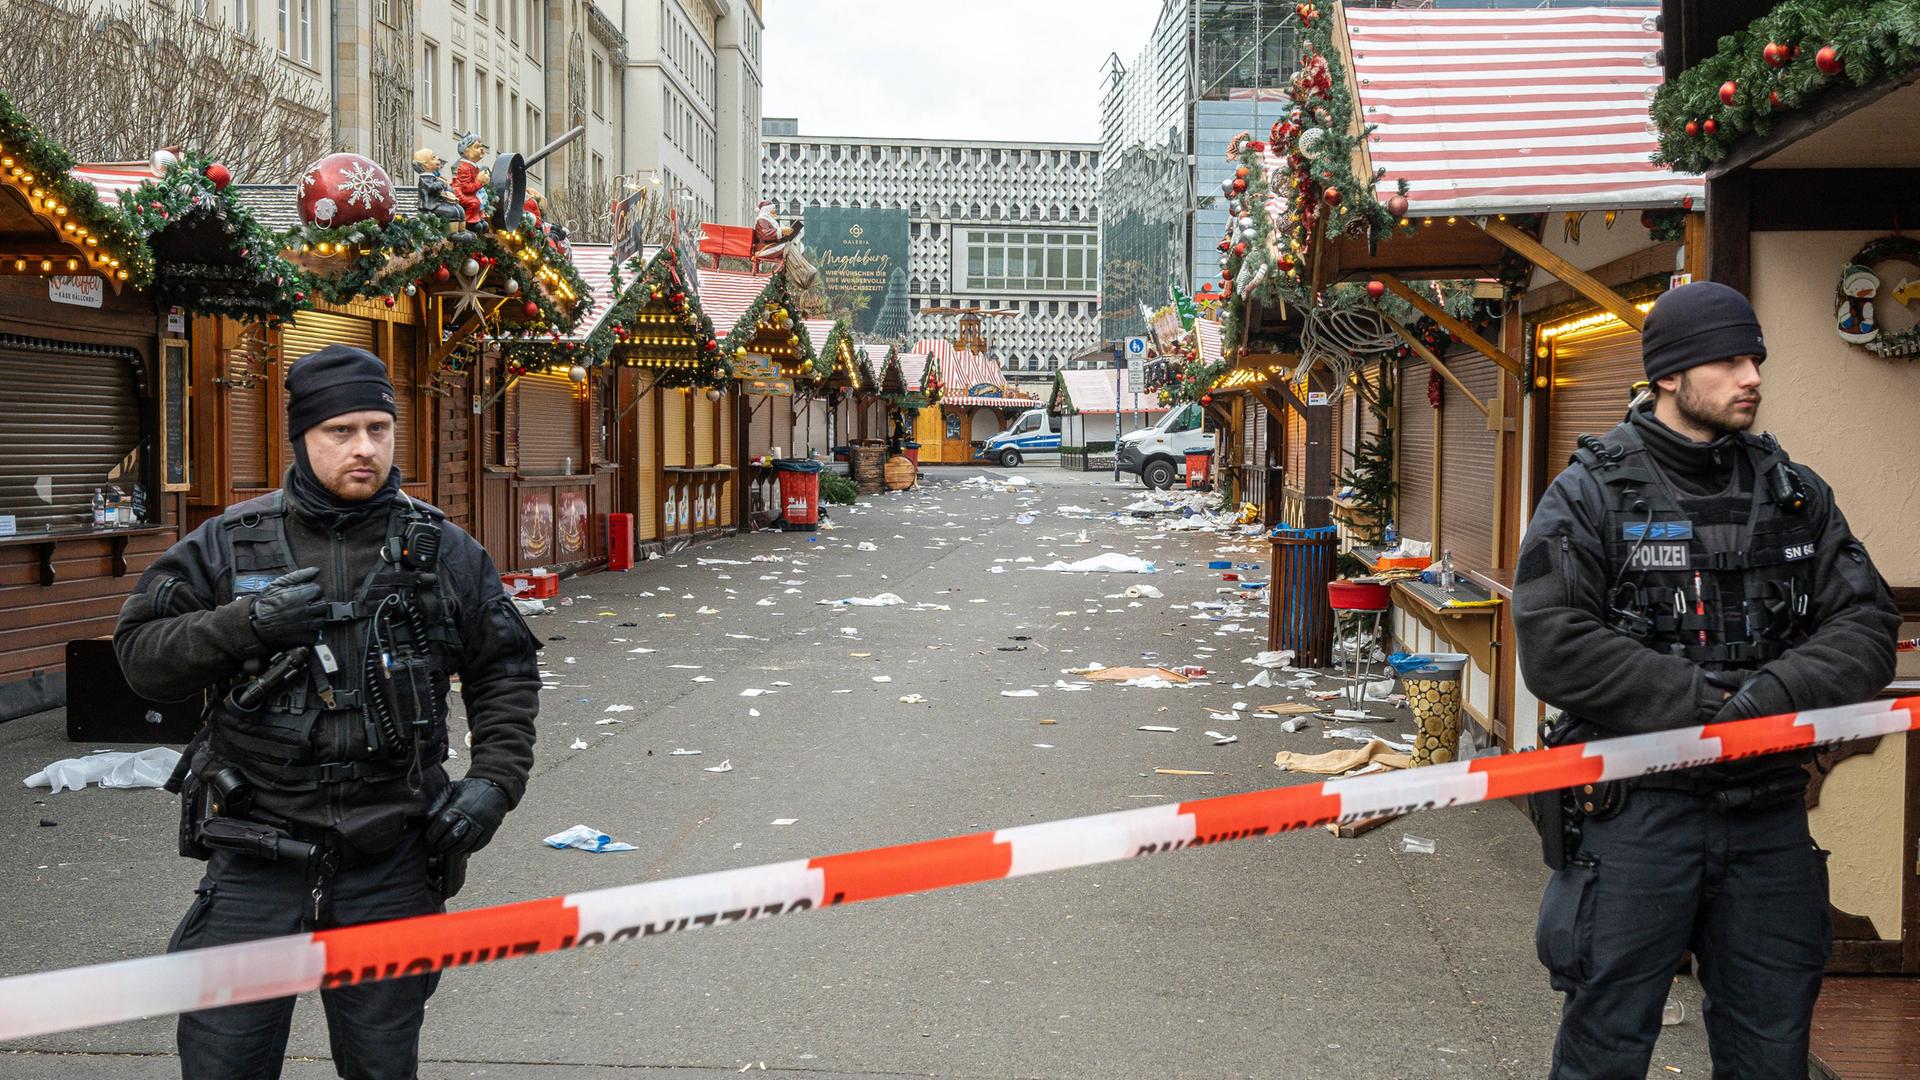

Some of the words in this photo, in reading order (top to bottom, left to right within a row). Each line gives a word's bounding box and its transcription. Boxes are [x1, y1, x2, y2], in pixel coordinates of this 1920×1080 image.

[840, 269, 875, 277] WÜNSCHEN
[1631, 545, 1687, 567] POLIZEI
[1784, 546, 1802, 559] SN
